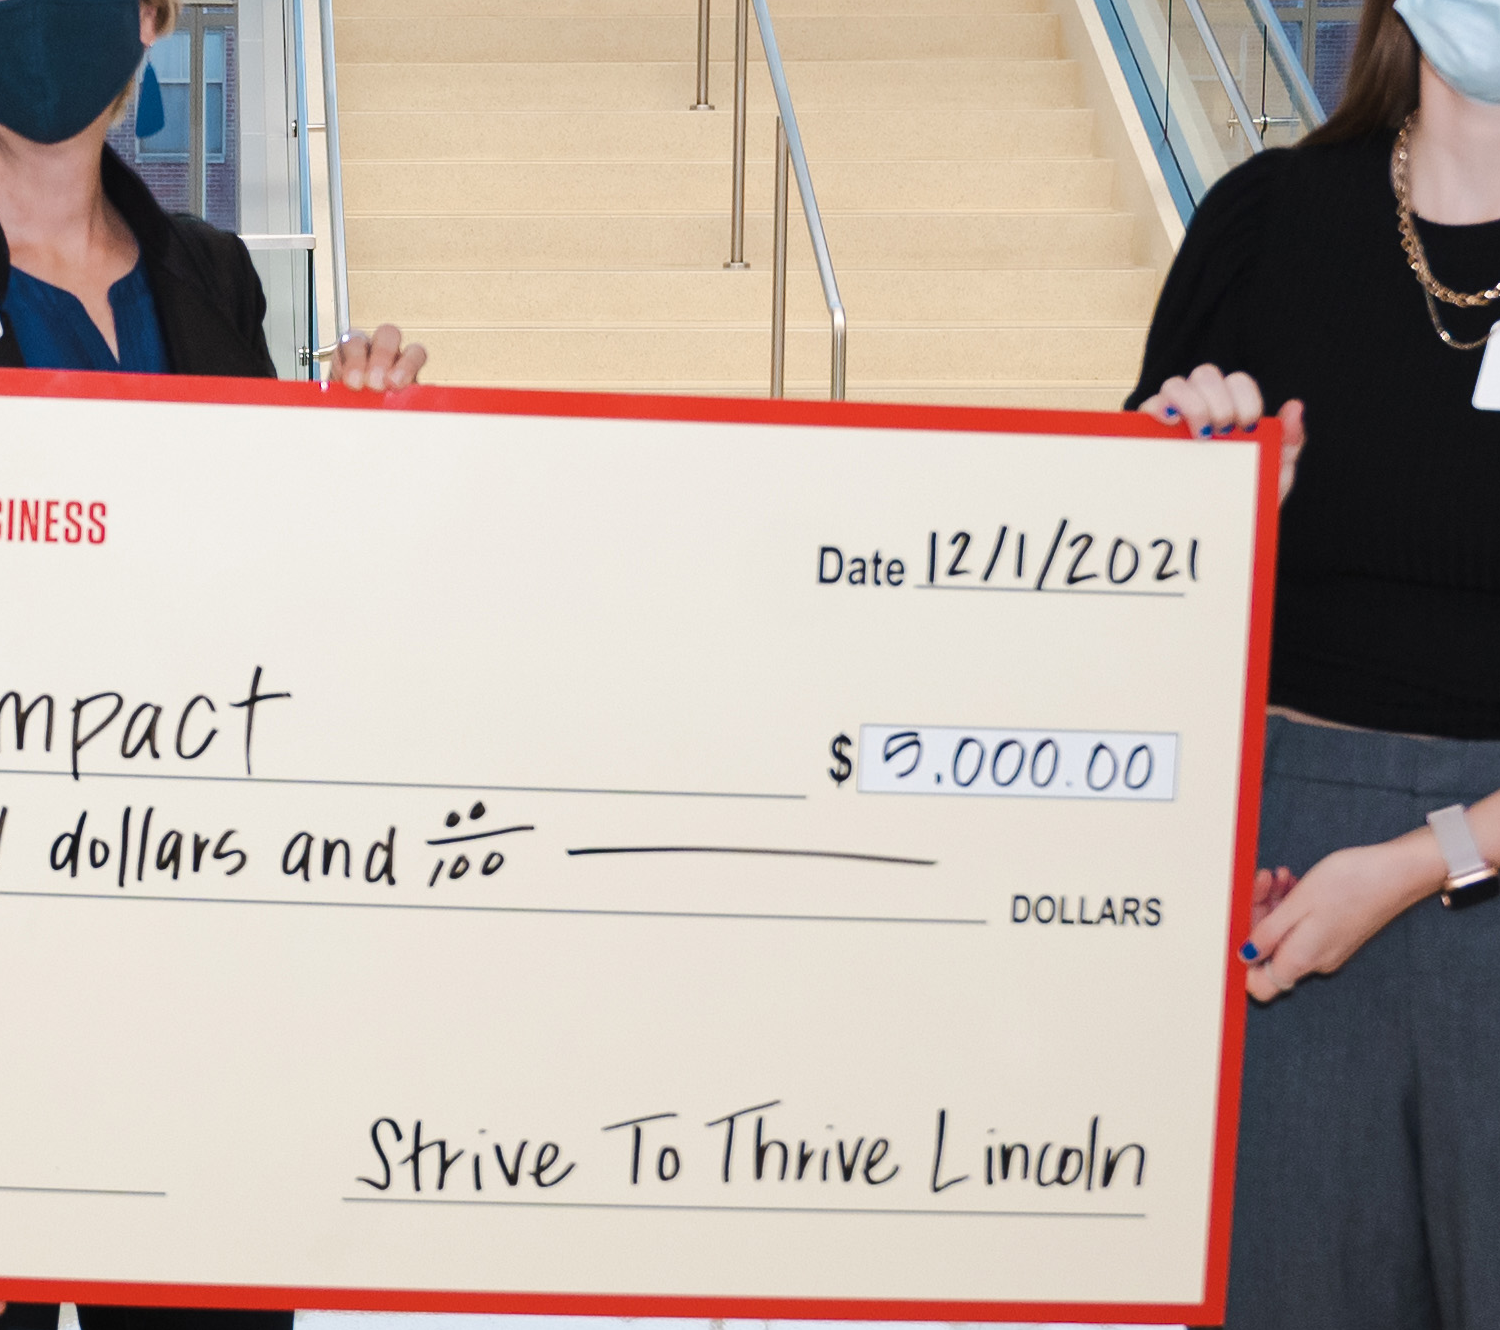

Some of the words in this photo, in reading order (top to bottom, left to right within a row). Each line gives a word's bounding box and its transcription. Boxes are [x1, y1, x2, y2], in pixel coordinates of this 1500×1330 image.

[817, 545, 906, 588] Date
[928, 518, 1199, 590] 12/1/2021
[828, 732, 853, 788] $
[49, 805, 248, 889] dollars
[281, 825, 398, 887] and
[1010, 894, 1162, 928] DOLLARS
[356, 1117, 577, 1193] Strive
[602, 1112, 681, 1185] To
[705, 1099, 900, 1186] Thrive
[930, 1108, 1146, 1194] Lincoln
